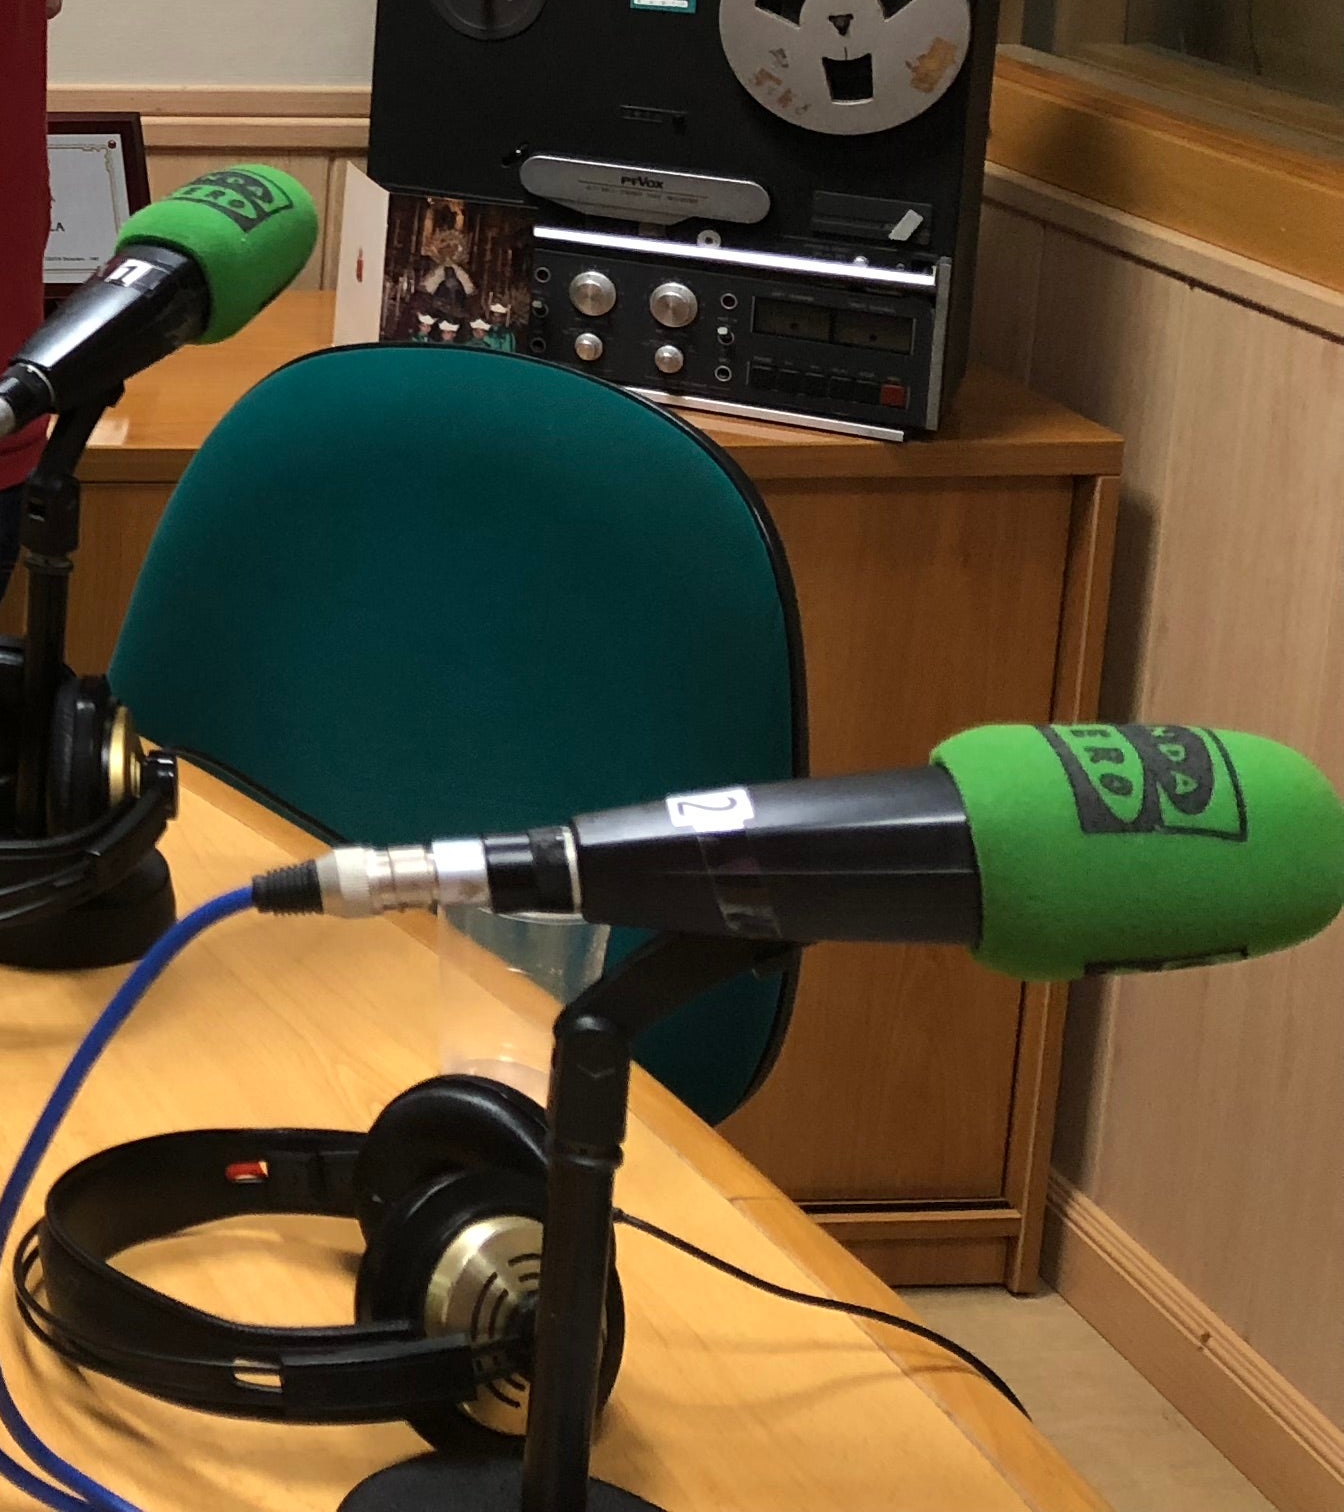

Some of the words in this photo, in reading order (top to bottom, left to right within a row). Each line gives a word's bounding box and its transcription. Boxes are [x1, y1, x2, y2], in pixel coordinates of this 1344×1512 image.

[180, 186, 246, 209] ERO
[109, 265, 139, 287] 1
[677, 796, 738, 817] 2
